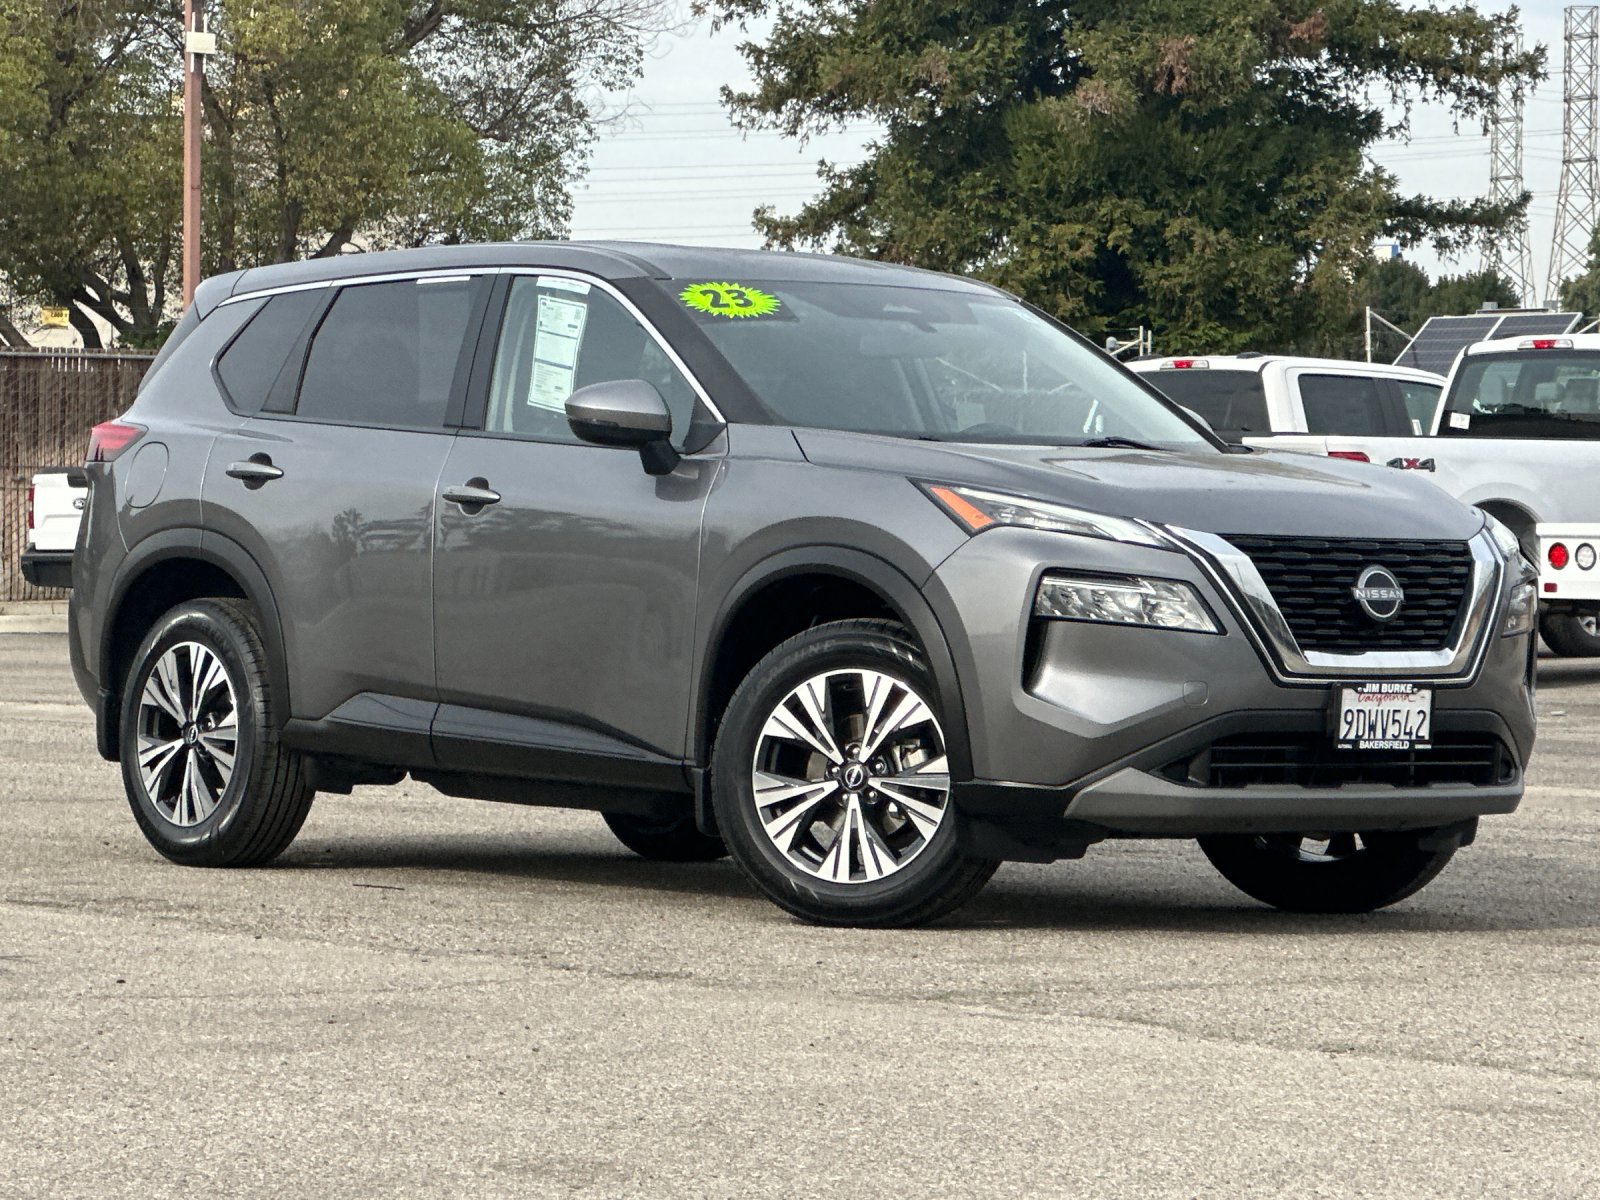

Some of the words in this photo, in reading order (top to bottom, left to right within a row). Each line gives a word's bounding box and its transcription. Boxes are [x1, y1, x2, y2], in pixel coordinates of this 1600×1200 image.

[699, 289, 753, 309] 23
[1355, 589, 1404, 599] NISSAN
[1363, 683, 1380, 693] JIM
[1381, 683, 1413, 693] BURKE
[1343, 708, 1427, 740] 9DWV542
[1359, 741, 1410, 749] BAKERSFIELD
